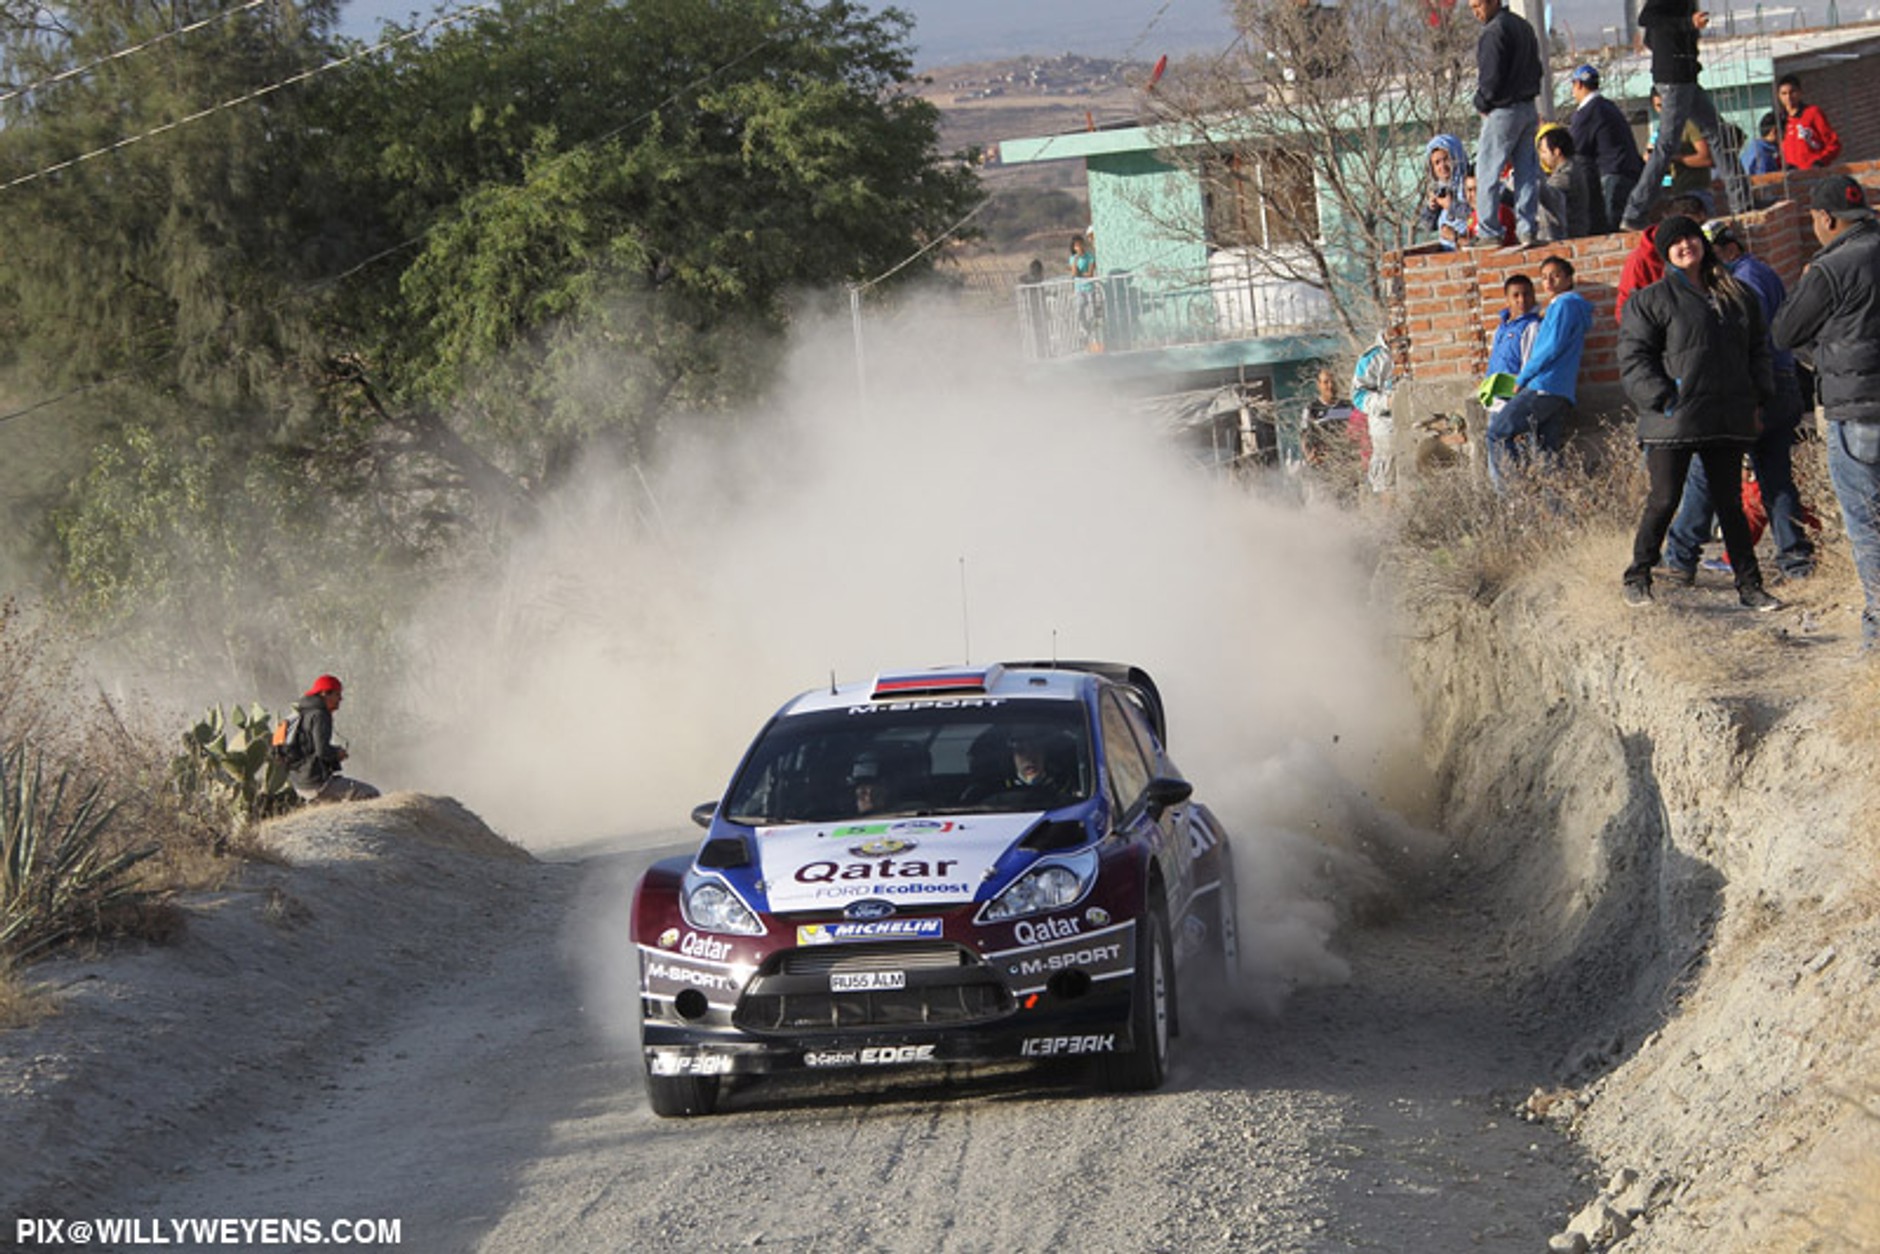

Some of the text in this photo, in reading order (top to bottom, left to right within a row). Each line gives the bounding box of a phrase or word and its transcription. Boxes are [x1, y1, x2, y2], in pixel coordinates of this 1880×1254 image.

[848, 698, 1007, 715] M-SPORT
[794, 858, 959, 884] Qatar
[815, 882, 970, 898] FORD EcoBoost
[834, 920, 939, 936] MICHELIN
[1014, 916, 1080, 946] Qatar
[681, 931, 733, 960] Qatar
[1020, 944, 1121, 976] M-SPORT
[648, 962, 728, 990] M-SPORT
[817, 1044, 936, 1066] Castrol EDGE
